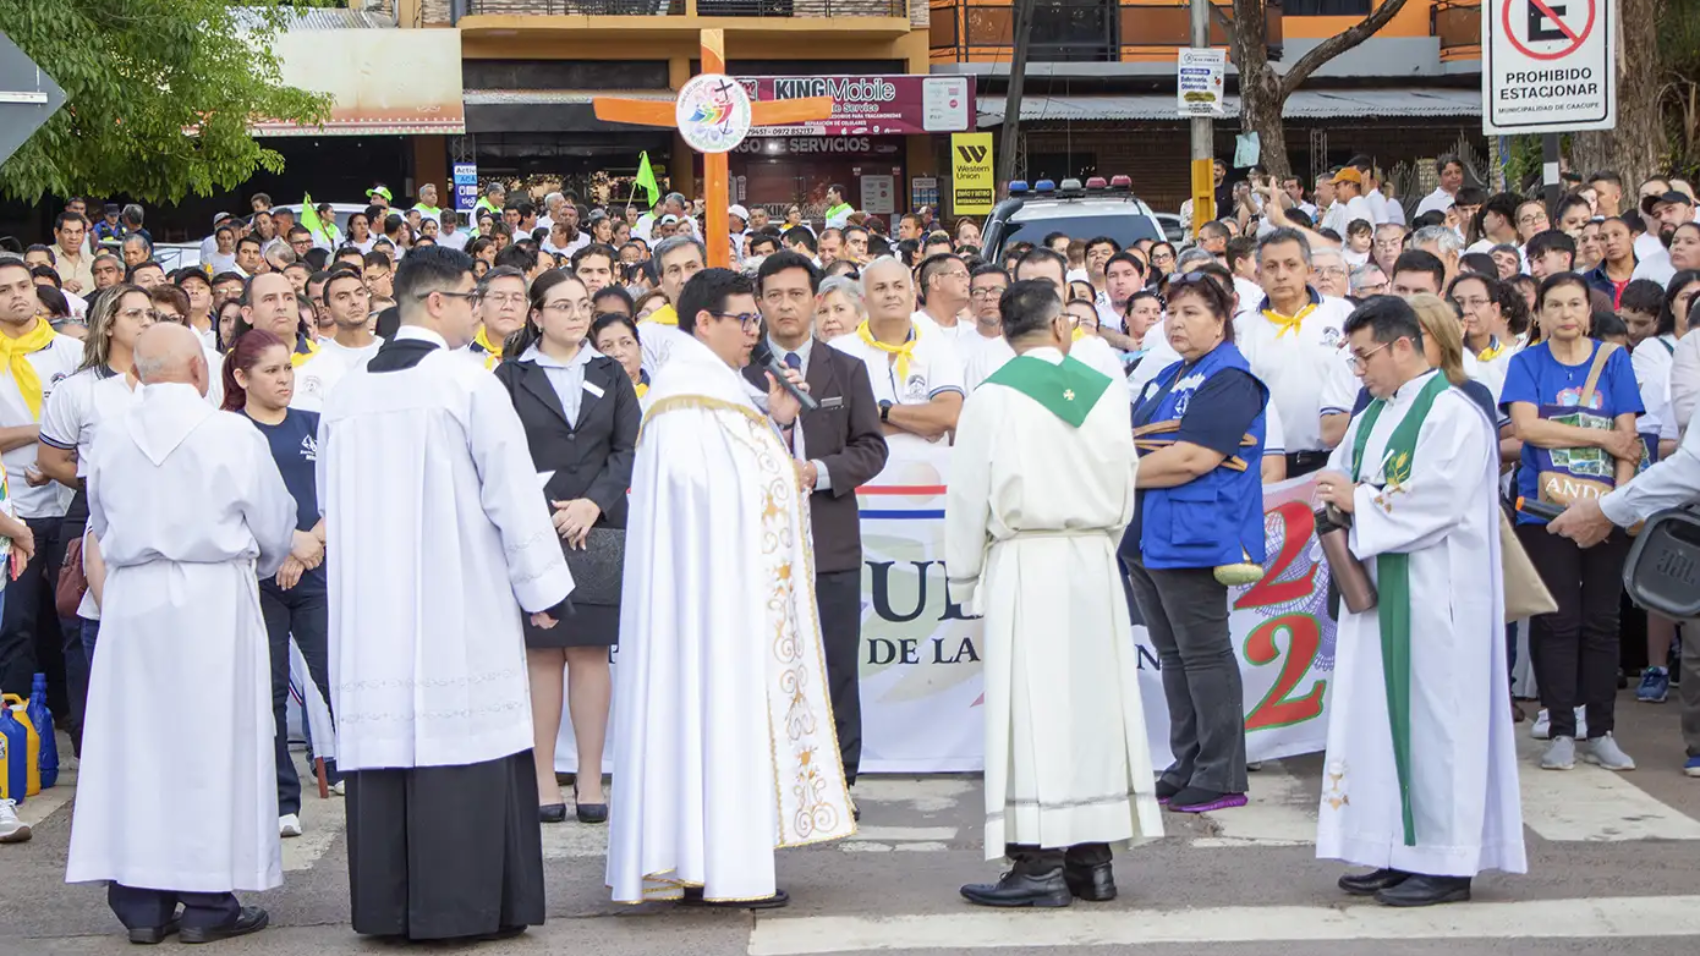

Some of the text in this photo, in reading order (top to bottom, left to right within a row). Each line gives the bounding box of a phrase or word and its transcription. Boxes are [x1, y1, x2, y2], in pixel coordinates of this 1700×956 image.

[1506, 67, 1592, 84] PROHIBIDO
[774, 77, 896, 101] KING Mobile
[1500, 83, 1598, 100] ESTACIONAR
[843, 102, 879, 112] Service
[1498, 104, 1553, 114] MUNICIPALIDAD
[748, 127, 766, 135] 79451
[773, 127, 789, 135] 0972
[790, 138, 870, 152] SERVICIOS
[956, 172, 980, 180] Union
[1656, 549, 1695, 585] JBL
[867, 638, 920, 665] DE
[932, 637, 981, 665] LA
